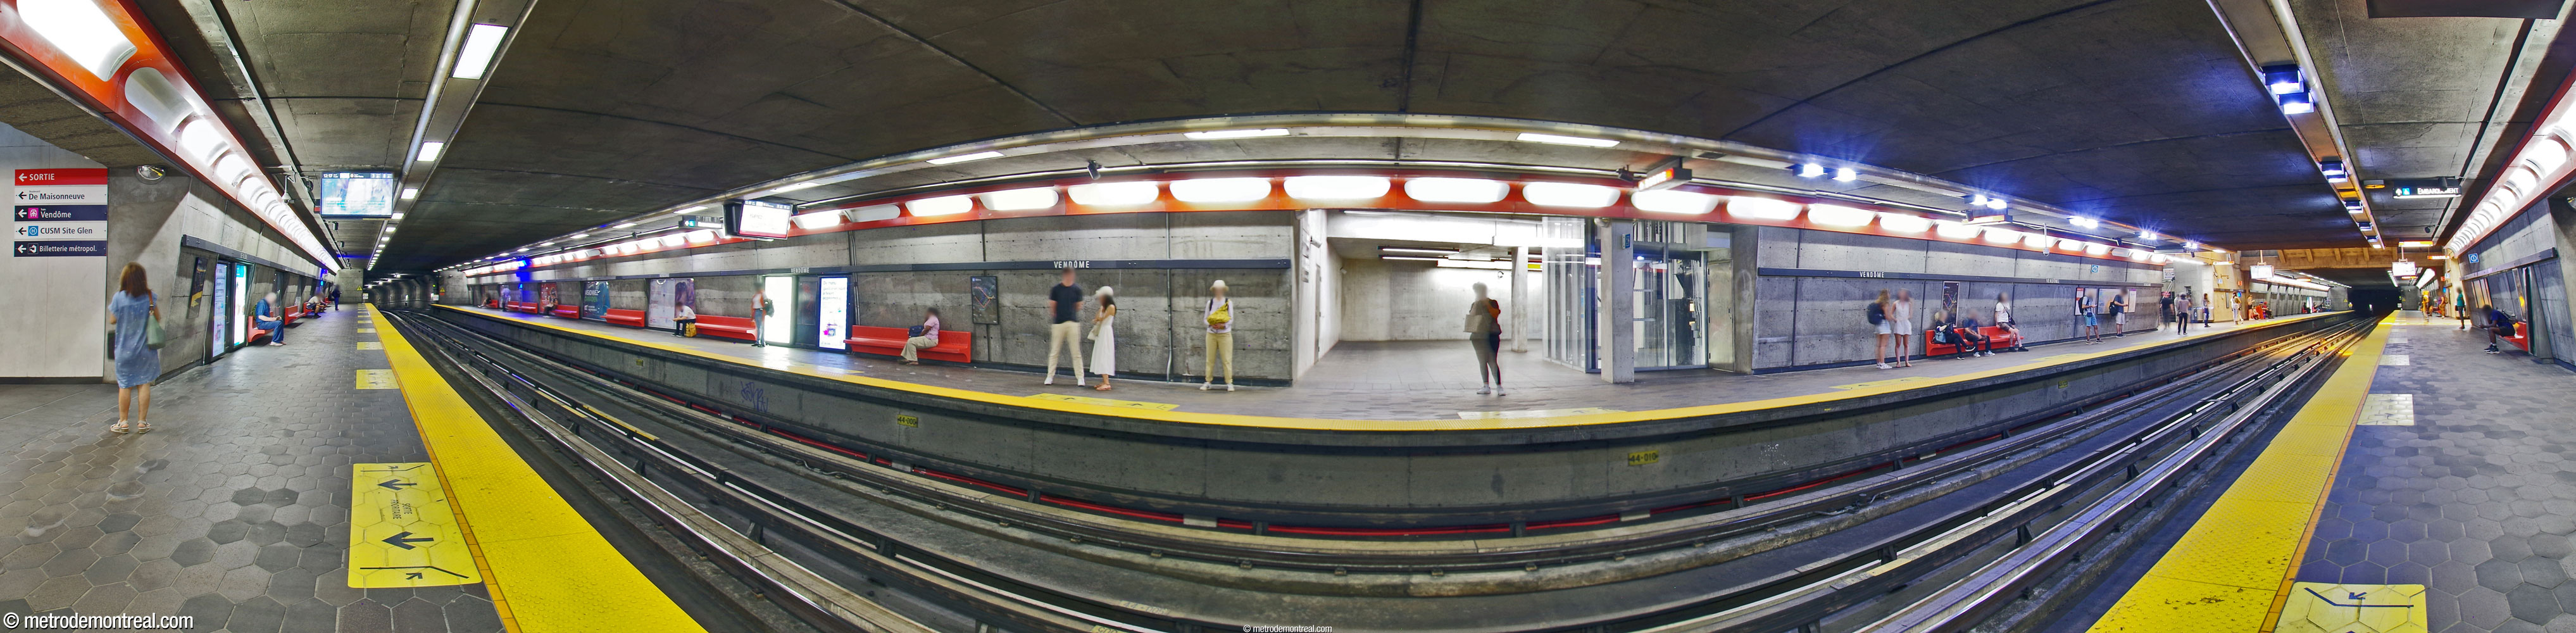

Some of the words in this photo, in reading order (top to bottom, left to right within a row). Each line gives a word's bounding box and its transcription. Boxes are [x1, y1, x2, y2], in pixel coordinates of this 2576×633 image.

[69, 245, 97, 253] métropol.
[1053, 260, 1090, 268] VENDÔME
[391, 499, 401, 519] PRIORITAIRE
[402, 503, 413, 514] SORTIE
